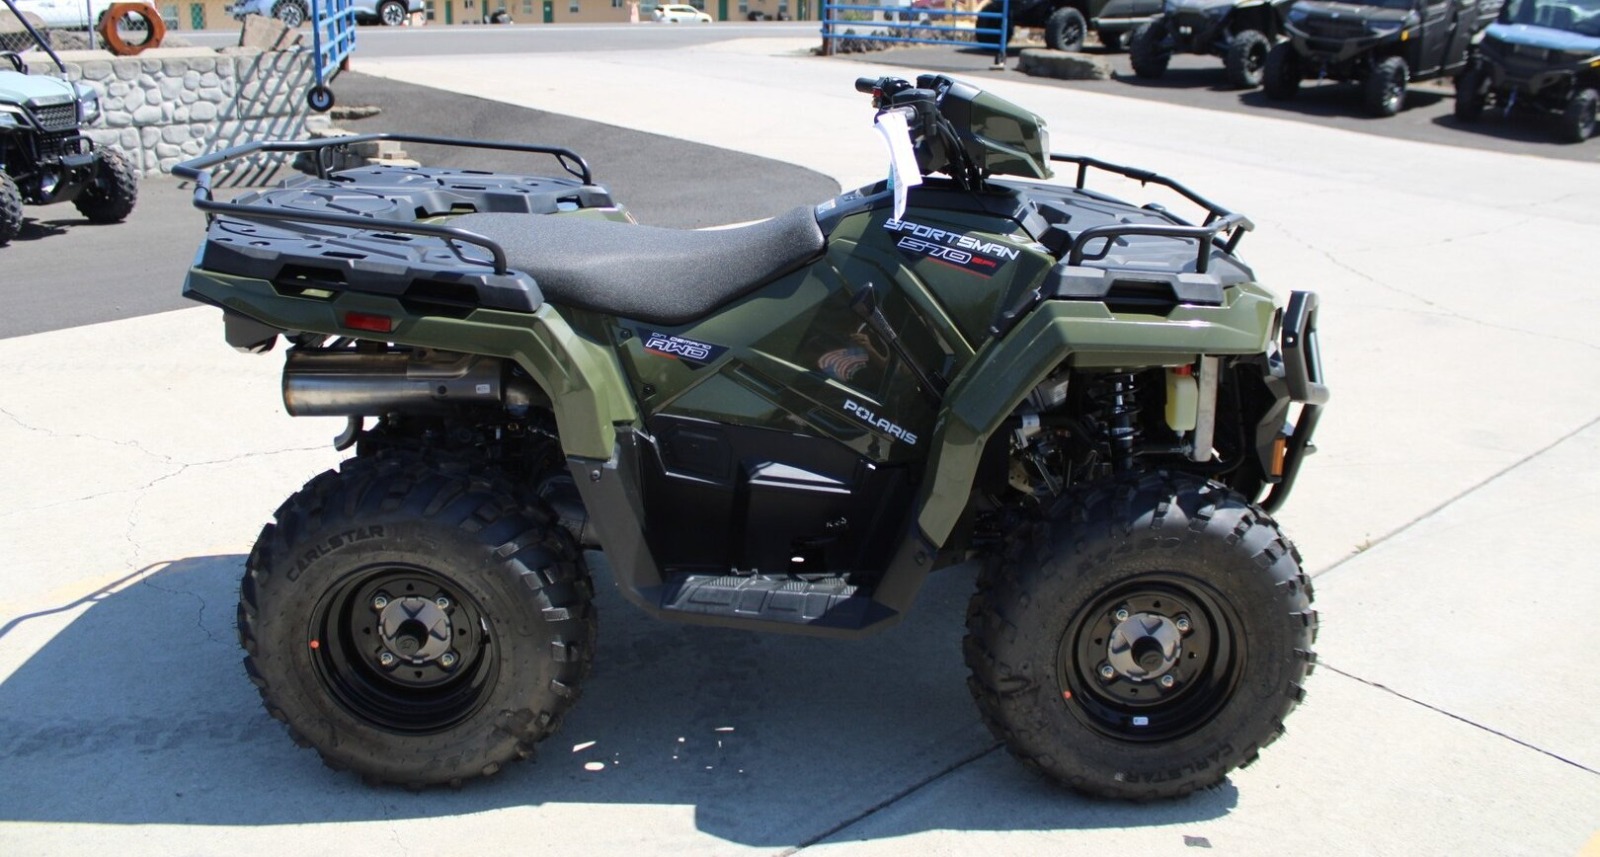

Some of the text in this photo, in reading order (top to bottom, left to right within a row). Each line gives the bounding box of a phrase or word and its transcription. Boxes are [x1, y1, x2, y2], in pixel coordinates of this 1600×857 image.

[883, 218, 1020, 260] SPORTSMAN
[897, 236, 972, 265] 570
[645, 337, 709, 359] AWD
[843, 400, 918, 445] POLARIS
[286, 525, 385, 582] CARLSTAR
